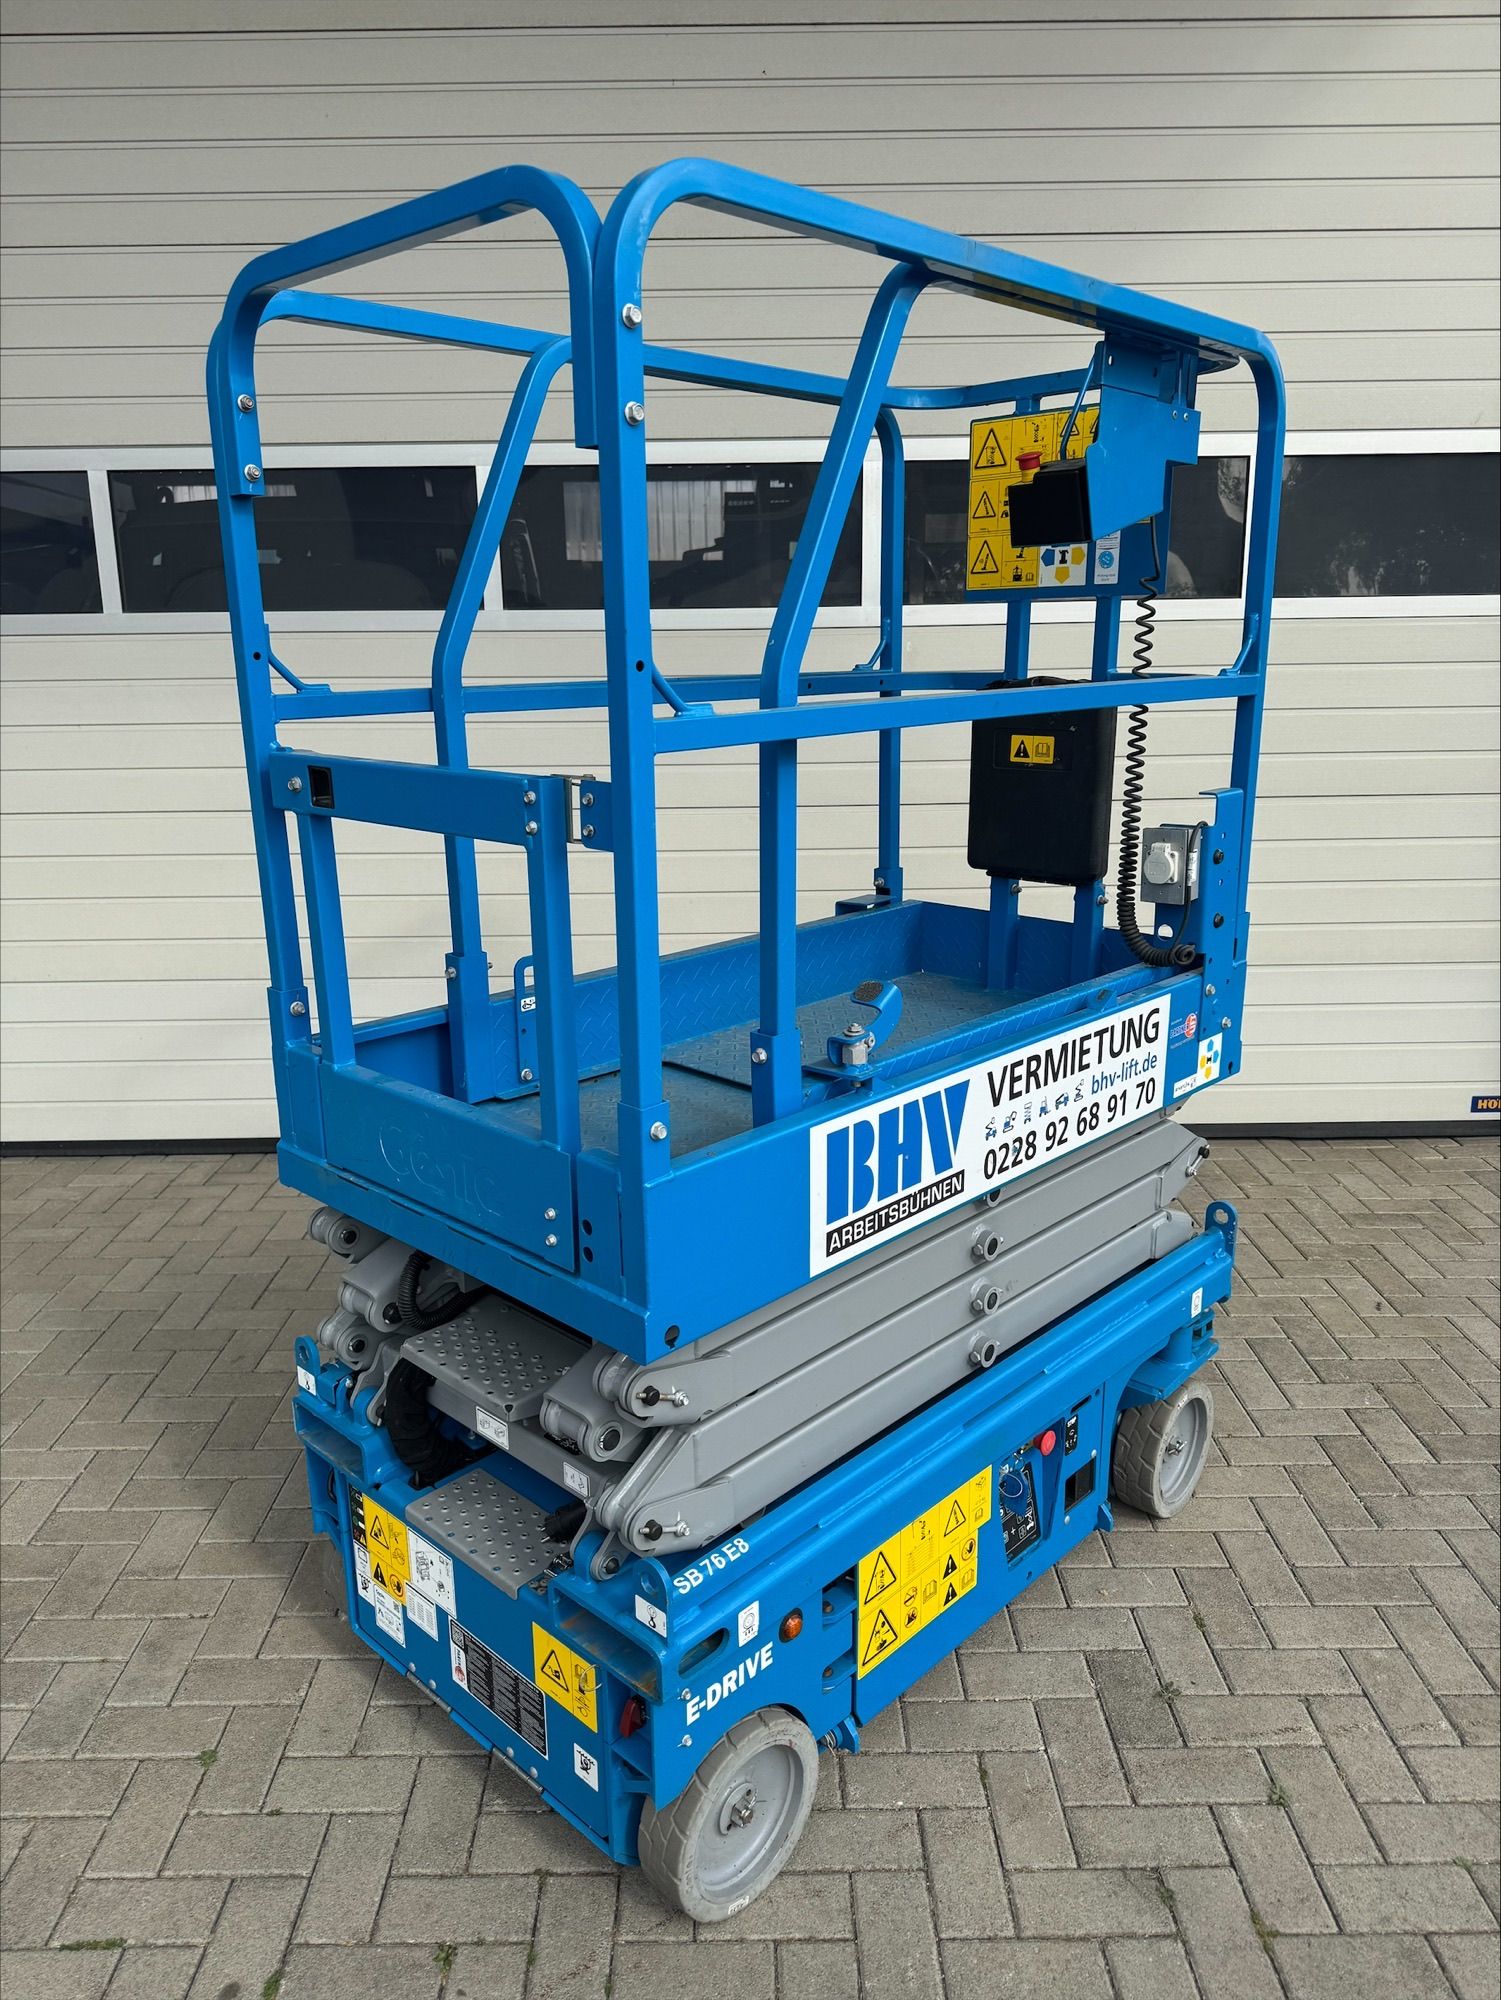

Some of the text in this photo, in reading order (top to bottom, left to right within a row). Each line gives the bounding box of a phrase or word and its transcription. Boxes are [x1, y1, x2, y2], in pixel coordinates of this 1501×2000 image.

[987, 1008, 1160, 1107] VERMIETUNG
[1091, 1052, 1157, 1095] bhv-lift.de
[827, 1079, 971, 1225] BHV
[983, 1132, 1037, 1179] 0228
[1045, 1117, 1068, 1151] 92
[1077, 1104, 1099, 1140] 68
[1107, 1090, 1128, 1127] 91
[1136, 1078, 1156, 1110] 70
[828, 1173, 963, 1252] ARBEITSBÜHNEN
[673, 1538, 750, 1594] SB 76 E8
[687, 1641, 773, 1726] E-DRIVE
